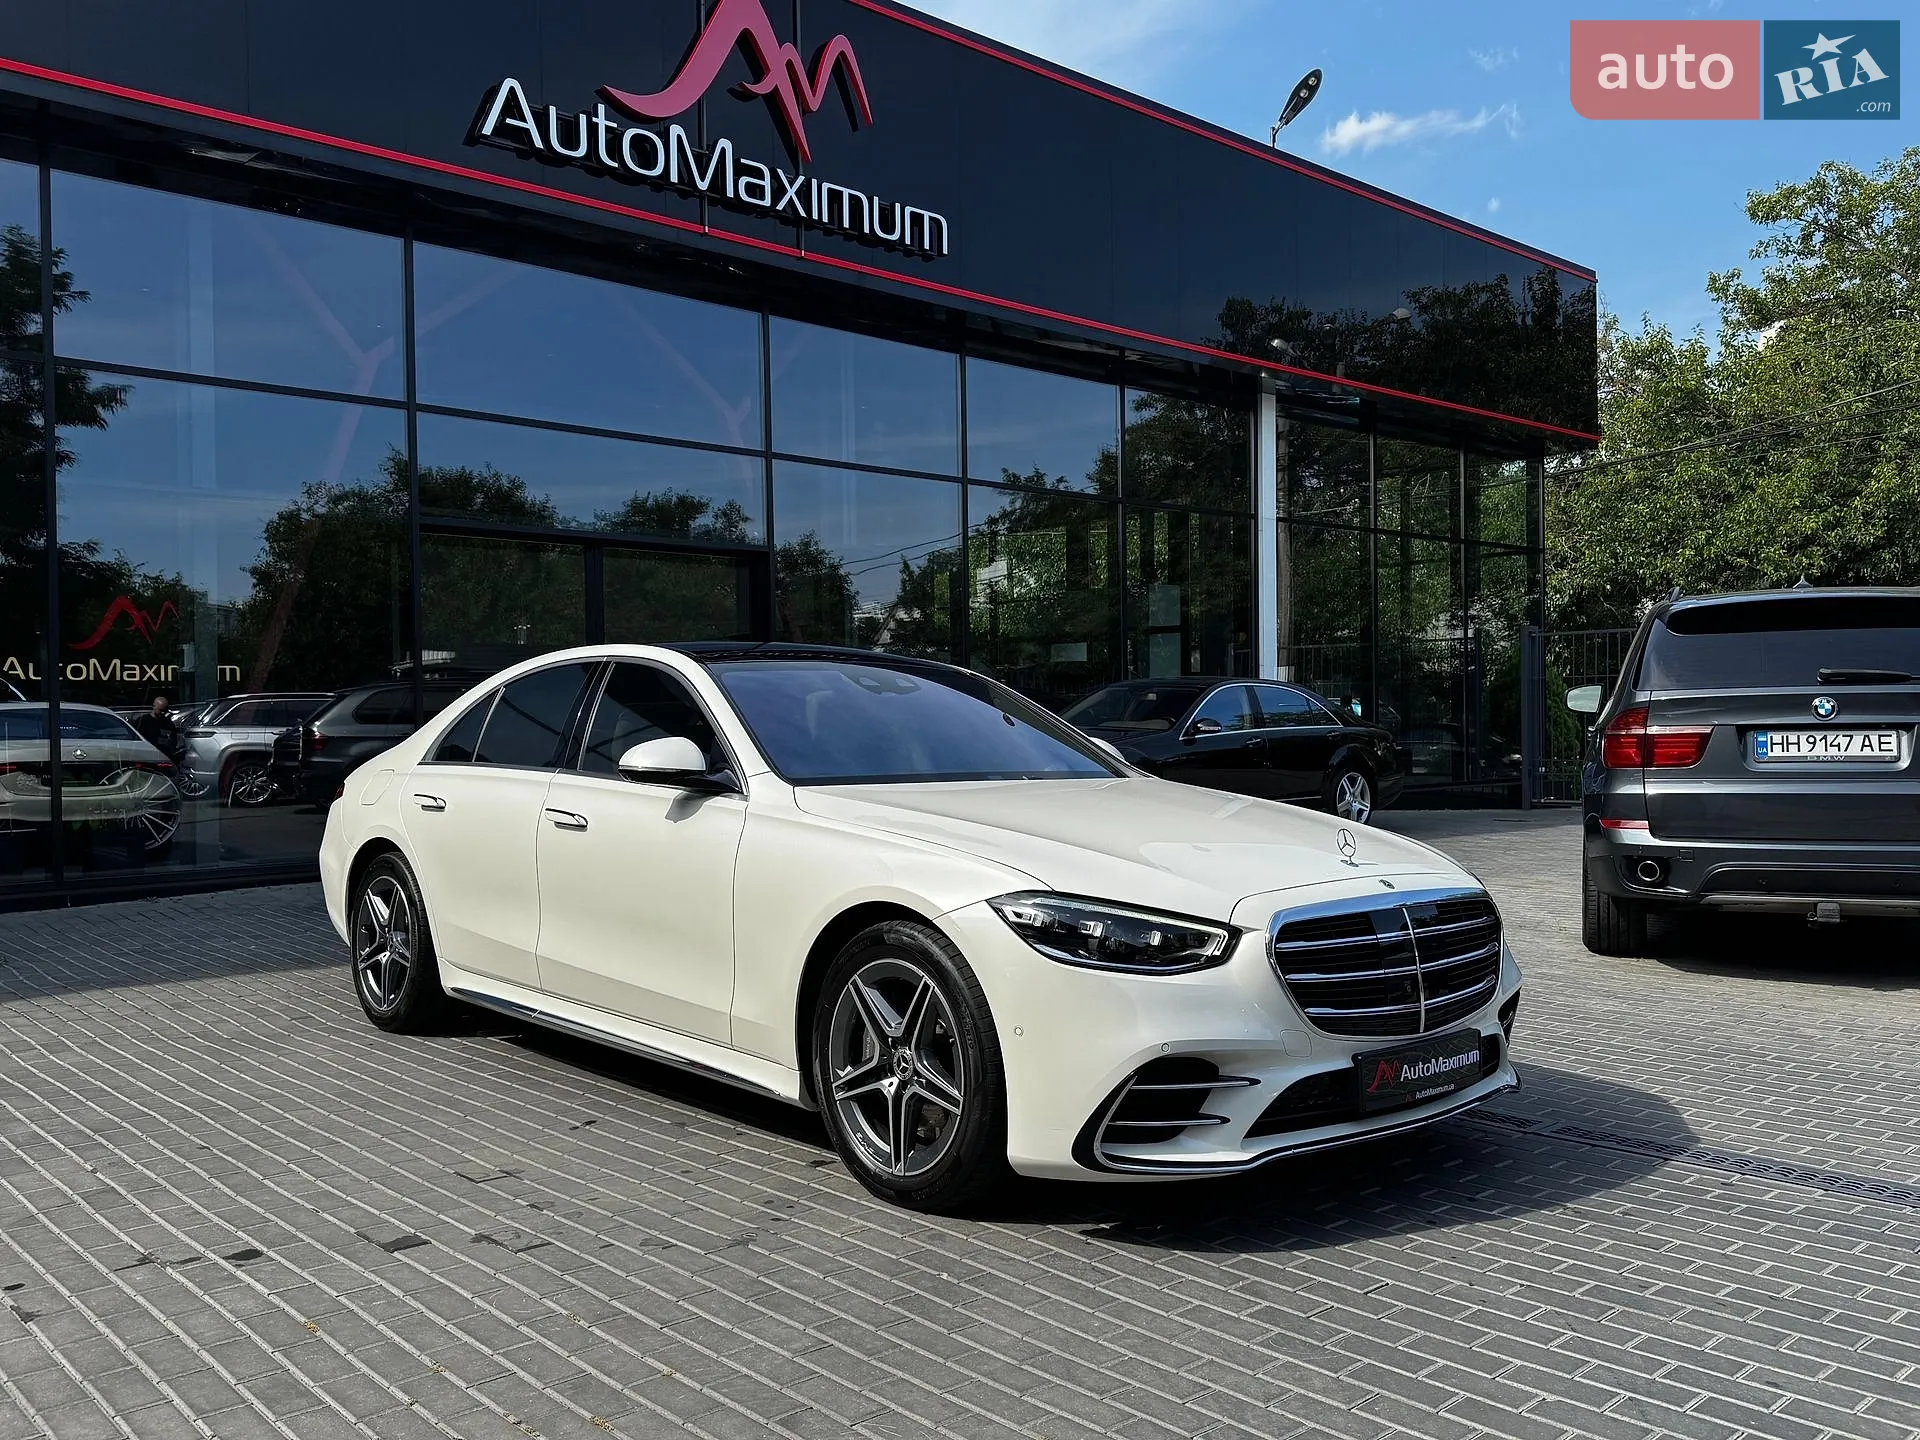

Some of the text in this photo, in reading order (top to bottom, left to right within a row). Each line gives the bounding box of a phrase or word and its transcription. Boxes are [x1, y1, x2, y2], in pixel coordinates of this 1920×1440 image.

[481, 77, 949, 256] AutoMaximum
[1769, 733, 1894, 753] HH 9147 AE
[1400, 1049, 1480, 1082] AutoMaximum
